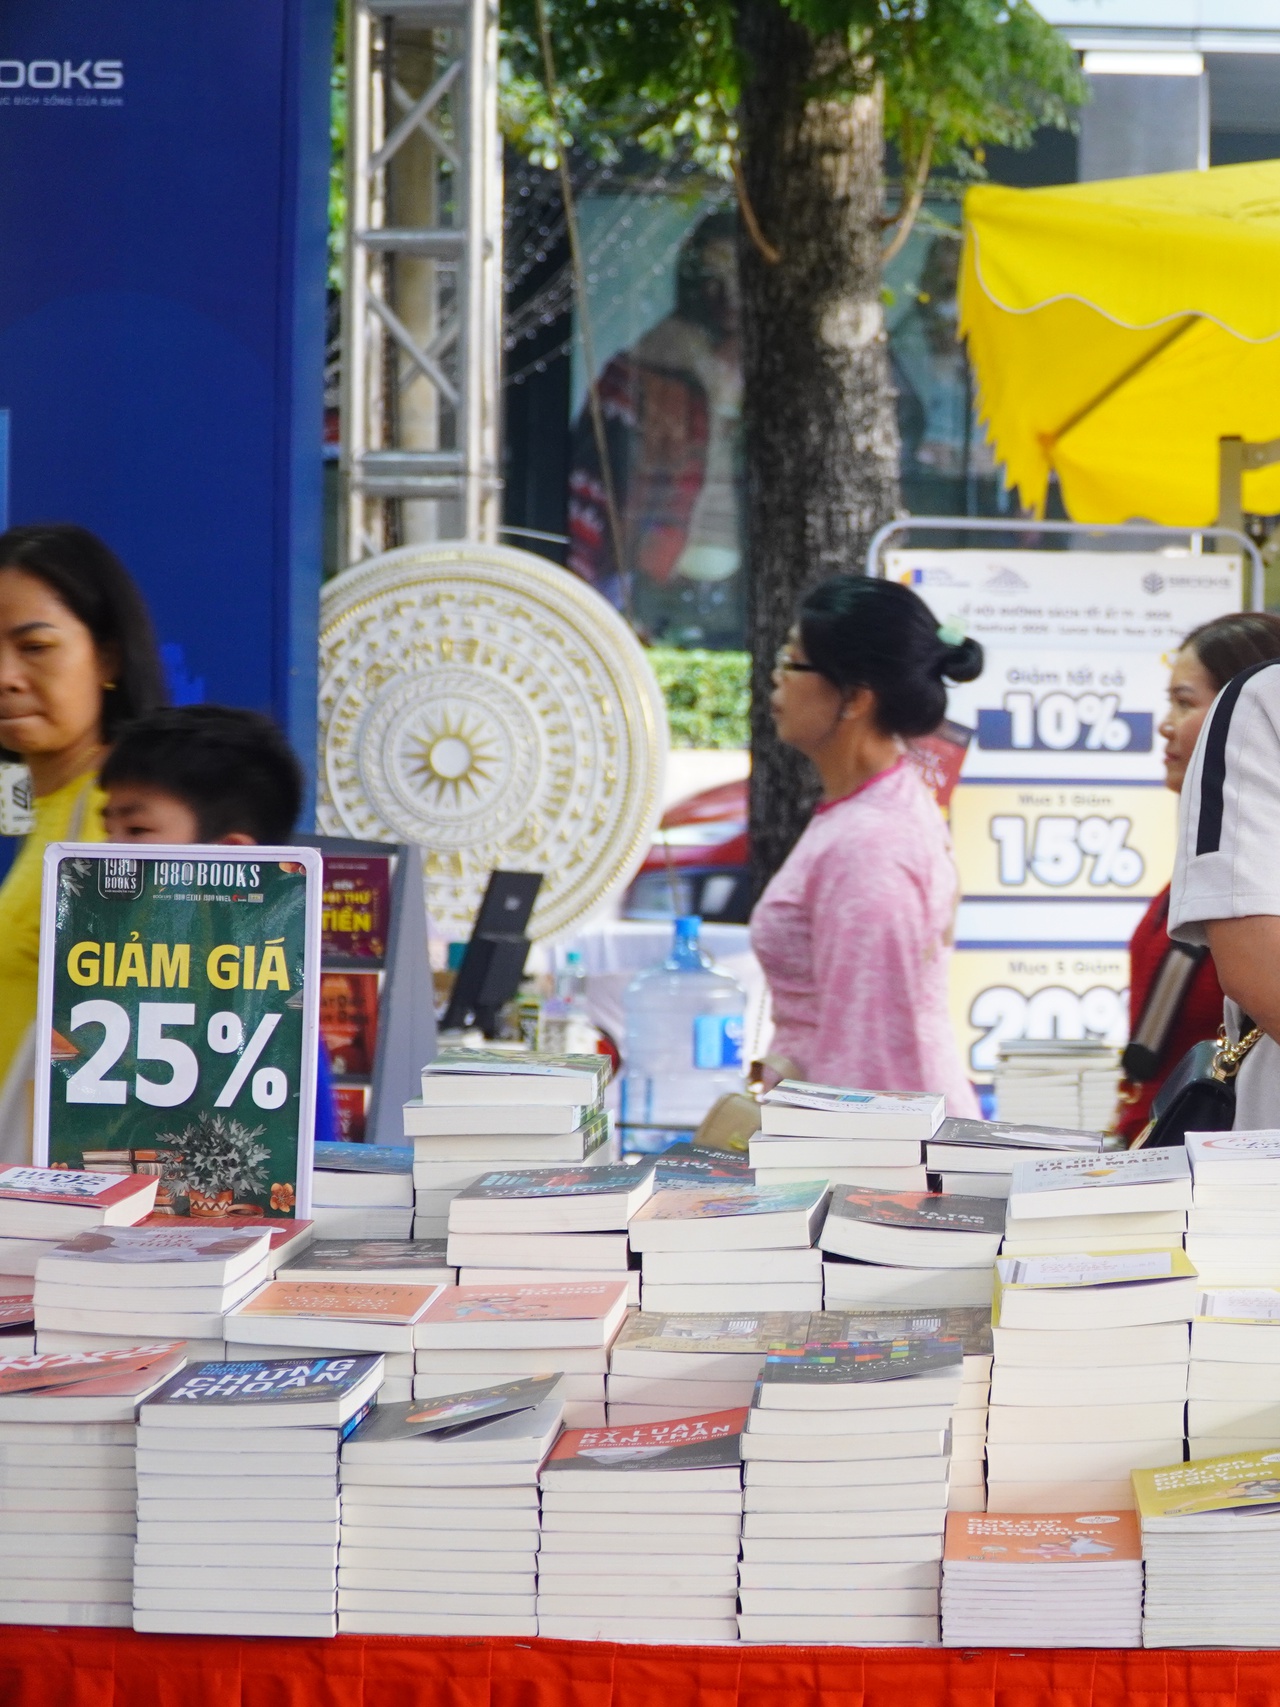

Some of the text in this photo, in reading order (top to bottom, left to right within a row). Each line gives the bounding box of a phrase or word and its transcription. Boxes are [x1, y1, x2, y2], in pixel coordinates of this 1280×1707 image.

[1005, 691, 1132, 750] 10%
[990, 816, 1144, 886] 15%
[105, 877, 137, 889] BOOKS
[67, 931, 290, 991] GIẢM GIÁ
[65, 999, 289, 1110] 25%
[632, 1421, 709, 1437] LUẬT
